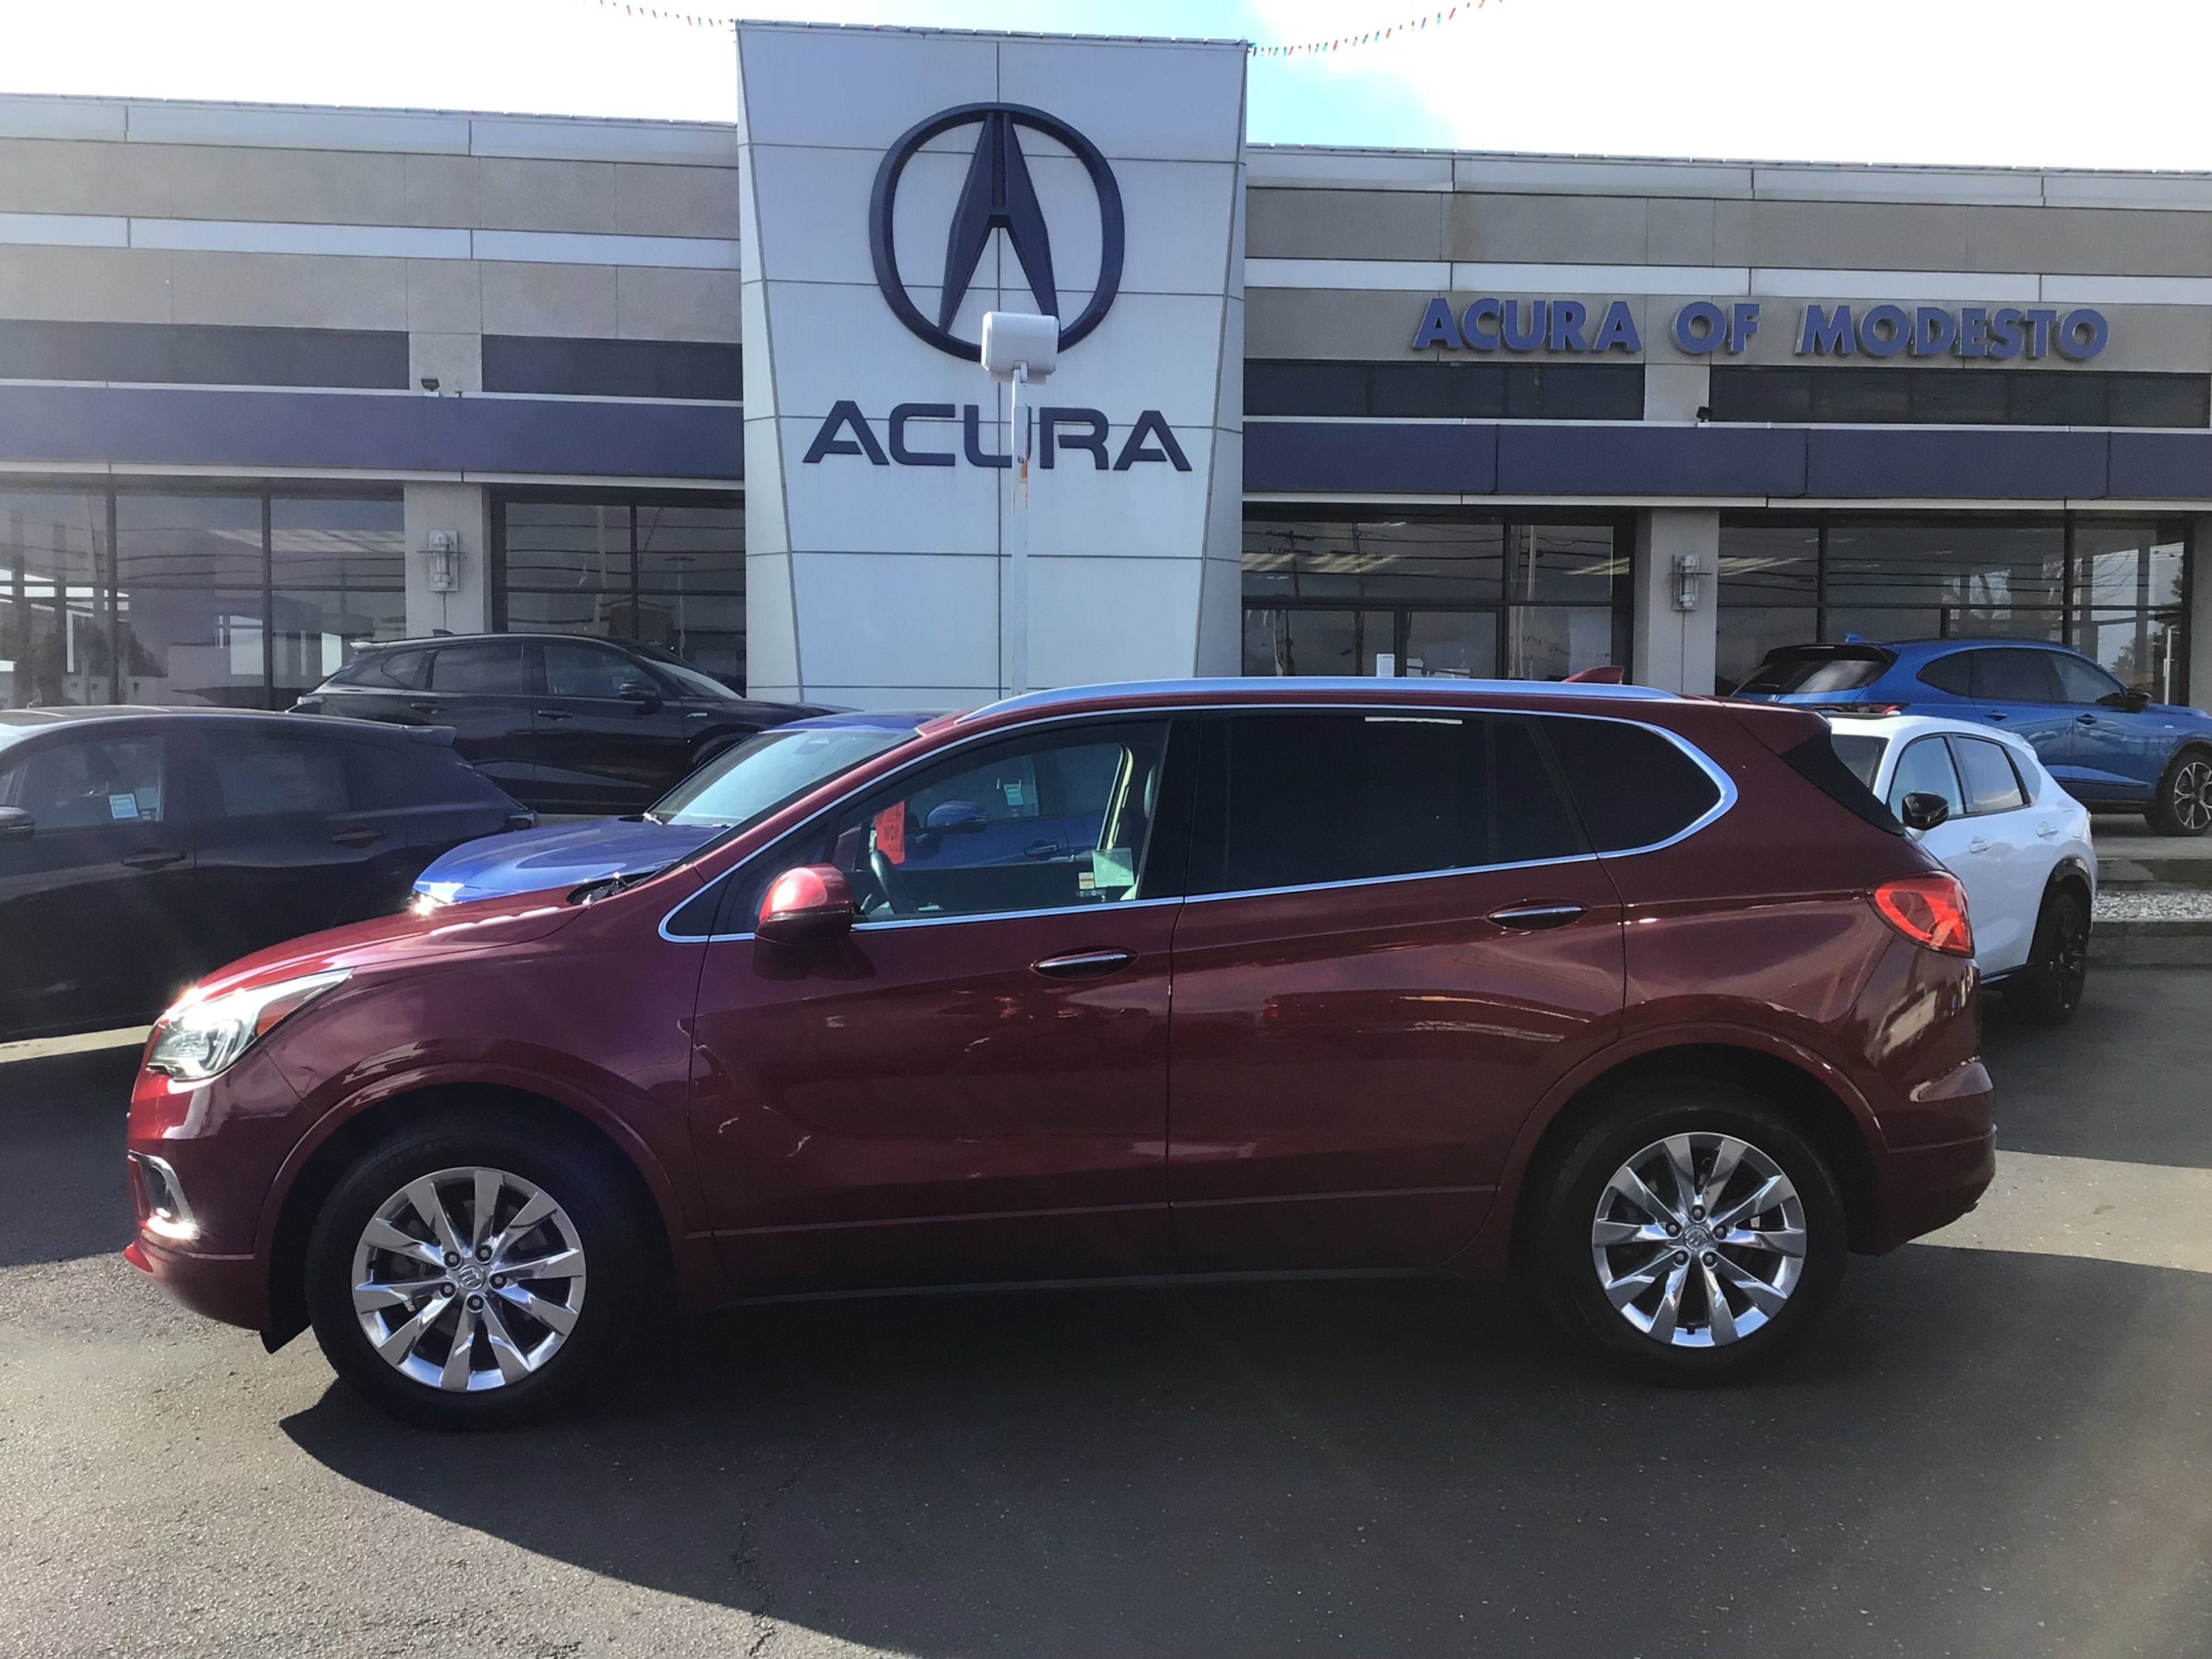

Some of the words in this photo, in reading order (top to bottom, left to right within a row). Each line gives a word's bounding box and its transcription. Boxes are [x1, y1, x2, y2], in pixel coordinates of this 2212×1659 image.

[1412, 298, 1642, 351] ACURA
[1671, 301, 1761, 354] OF
[1796, 304, 2109, 359] MODESTO
[802, 401, 1192, 471] ACURA
